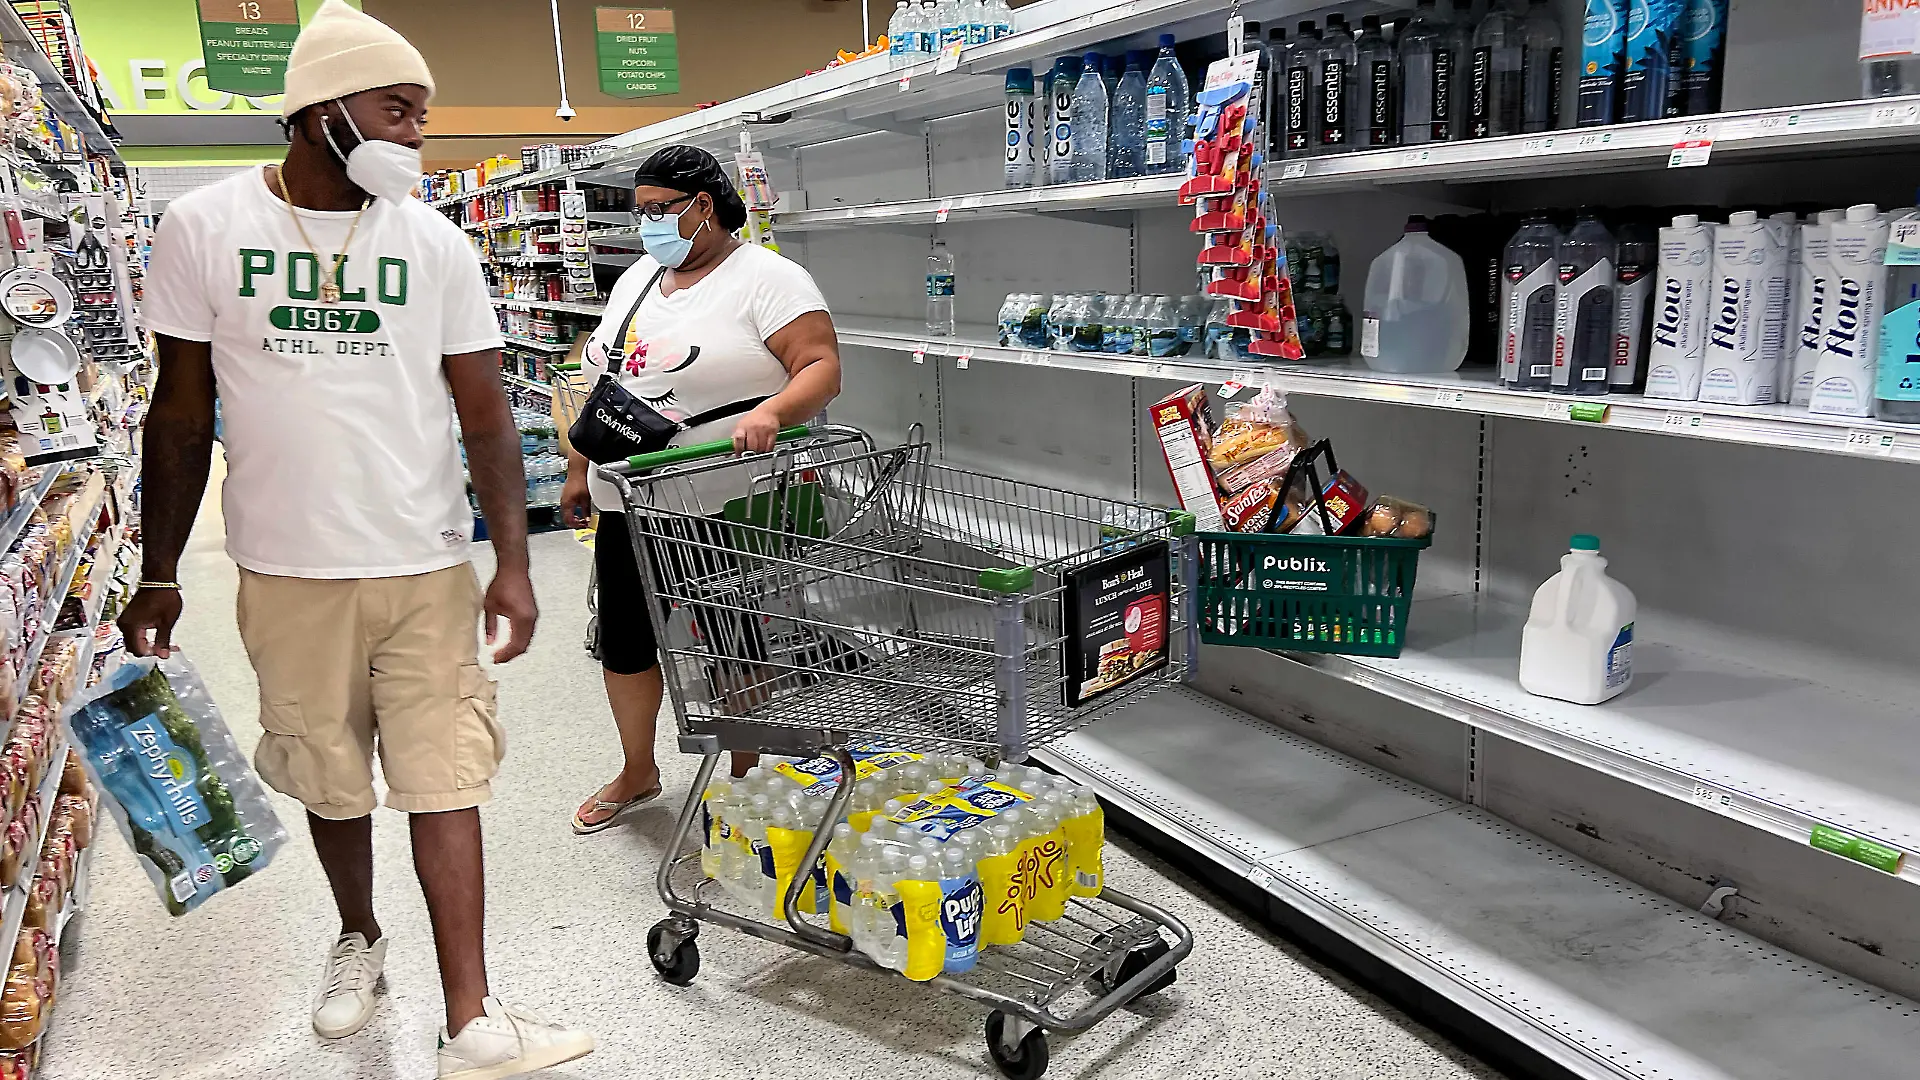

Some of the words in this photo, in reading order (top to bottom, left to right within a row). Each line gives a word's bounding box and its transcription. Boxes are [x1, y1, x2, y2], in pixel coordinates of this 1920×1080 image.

[235, 27, 268, 35] BREADS
[238, 2, 261, 20] 13
[626, 14, 645, 30] 12
[206, 39, 240, 48] PEANUT
[216, 52, 260, 61] SPECIALTY
[242, 66, 272, 74] WATER
[1290, 70, 1301, 128] essentia
[1324, 63, 1338, 122] essentia
[1374, 64, 1386, 123] essentia
[1436, 53, 1447, 116] essentia
[1473, 52, 1484, 116] essentia
[1007, 100, 1020, 162] core
[1056, 92, 1072, 156] core
[238, 248, 408, 306] POLO
[288, 308, 361, 332] 1967
[1554, 292, 1569, 367] BODYARMOR
[1616, 292, 1632, 366] BODYARMOR
[1652, 276, 1682, 348] flow
[1708, 274, 1740, 351] flow
[1820, 276, 1861, 358] flow
[262, 337, 324, 354] ATHL.
[336, 340, 396, 356] DEPT.
[596, 408, 622, 432] Calvin
[619, 424, 642, 444] Klein
[1241, 504, 1272, 532] HONEY
[1102, 574, 1120, 590] Boar's
[1127, 566, 1144, 580] Head
[130, 723, 198, 826] Zephyrhills
